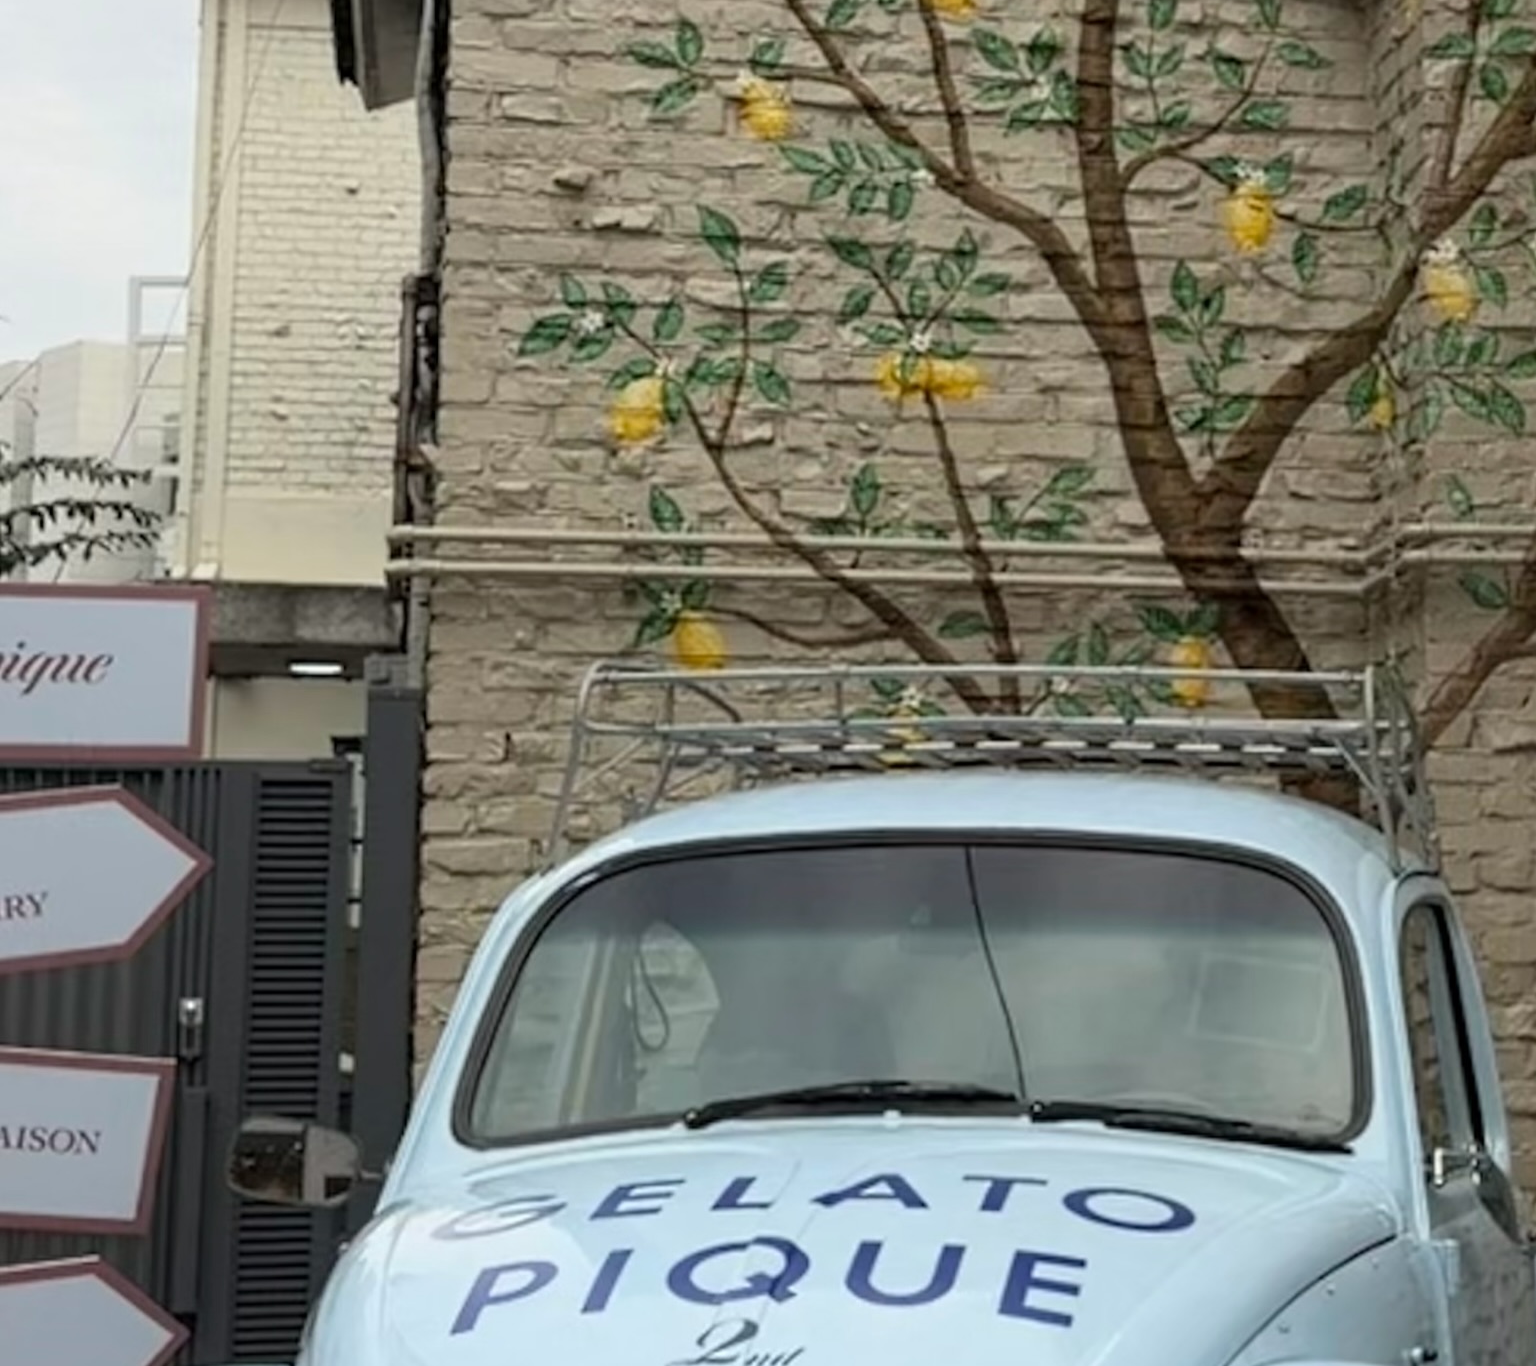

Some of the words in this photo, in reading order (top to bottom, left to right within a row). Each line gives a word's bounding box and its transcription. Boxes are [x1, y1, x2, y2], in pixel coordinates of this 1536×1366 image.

[0, 641, 114, 696] ique
[0, 891, 49, 920] RY
[431, 1172, 1197, 1241] GELATO
[449, 1236, 1088, 1337] PIQUE
